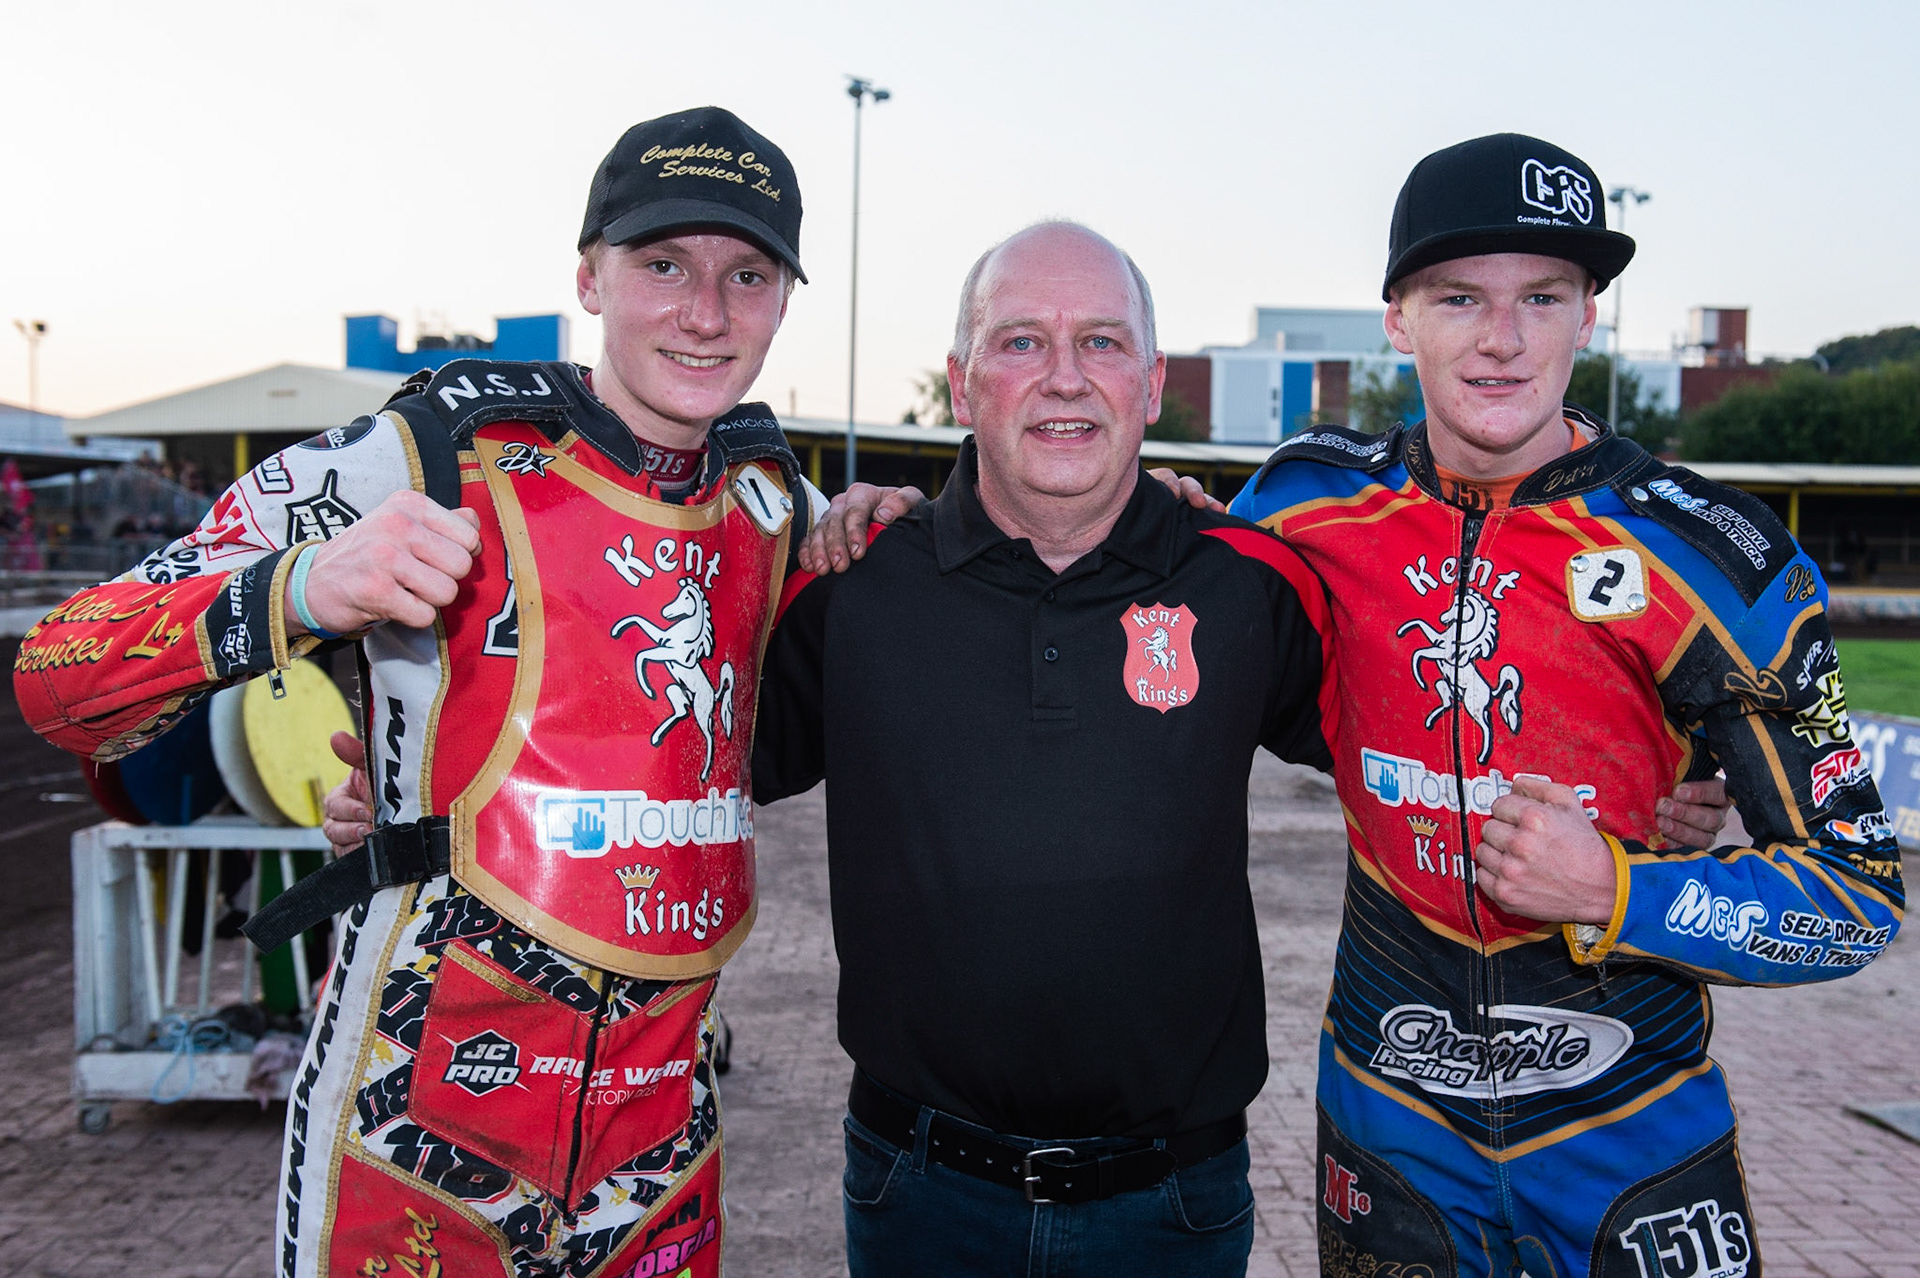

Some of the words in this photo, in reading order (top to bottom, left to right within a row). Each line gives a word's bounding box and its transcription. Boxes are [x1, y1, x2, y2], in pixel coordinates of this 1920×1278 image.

[640, 142, 733, 164] Complete
[738, 151, 772, 177] Car
[658, 160, 745, 184] Services
[751, 178, 781, 202] Ltd
[641, 444, 685, 475] 51's
[747, 477, 774, 520] 1
[291, 505, 328, 541] PR
[1690, 506, 1722, 525] VANS
[1717, 521, 1731, 532] &
[1726, 528, 1767, 571] TRUCKS
[1711, 504, 1743, 522] SELF
[1735, 518, 1771, 551] DRIVE
[604, 533, 722, 589] Kent
[1403, 553, 1521, 600] Kent
[1588, 558, 1625, 607] 2
[122, 611, 186, 661] Lt
[1132, 609, 1180, 628] Kent
[1137, 684, 1189, 706] Kings
[1414, 836, 1478, 885] Kin
[623, 888, 725, 941] Kings
[1780, 911, 1833, 939] SELF
[1832, 918, 1891, 947] DRIVE
[1747, 934, 1805, 965] VANS
[1803, 945, 1821, 966] &
[1820, 946, 1888, 967] TRUCK
[461, 1042, 512, 1061] JC
[1386, 1009, 1591, 1082] Chapple
[444, 1063, 522, 1085] PRO
[624, 1059, 691, 1086] WEAR
[1376, 1047, 1473, 1087] Racing
